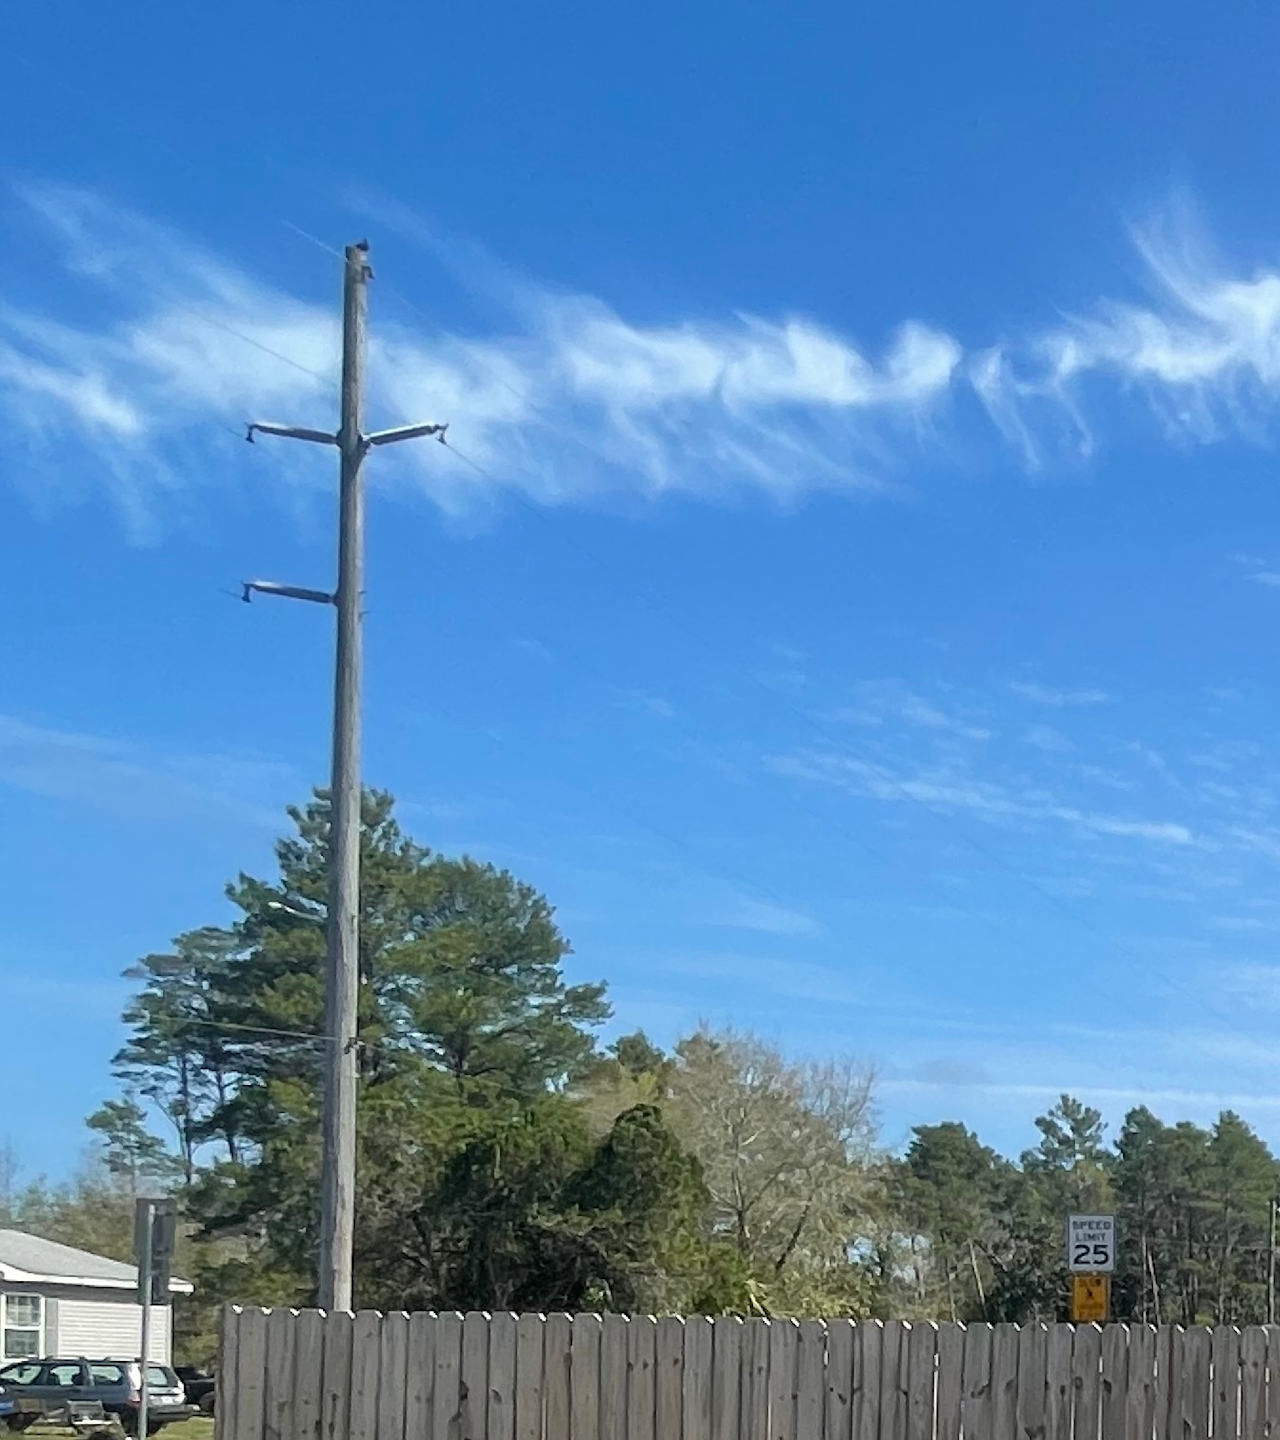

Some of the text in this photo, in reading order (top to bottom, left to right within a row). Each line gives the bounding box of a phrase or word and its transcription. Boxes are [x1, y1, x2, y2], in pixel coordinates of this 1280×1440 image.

[1072, 1220, 1112, 1230] SPEED
[1075, 1232, 1106, 1241] LIMIT
[1073, 1244, 1110, 1265] 25
